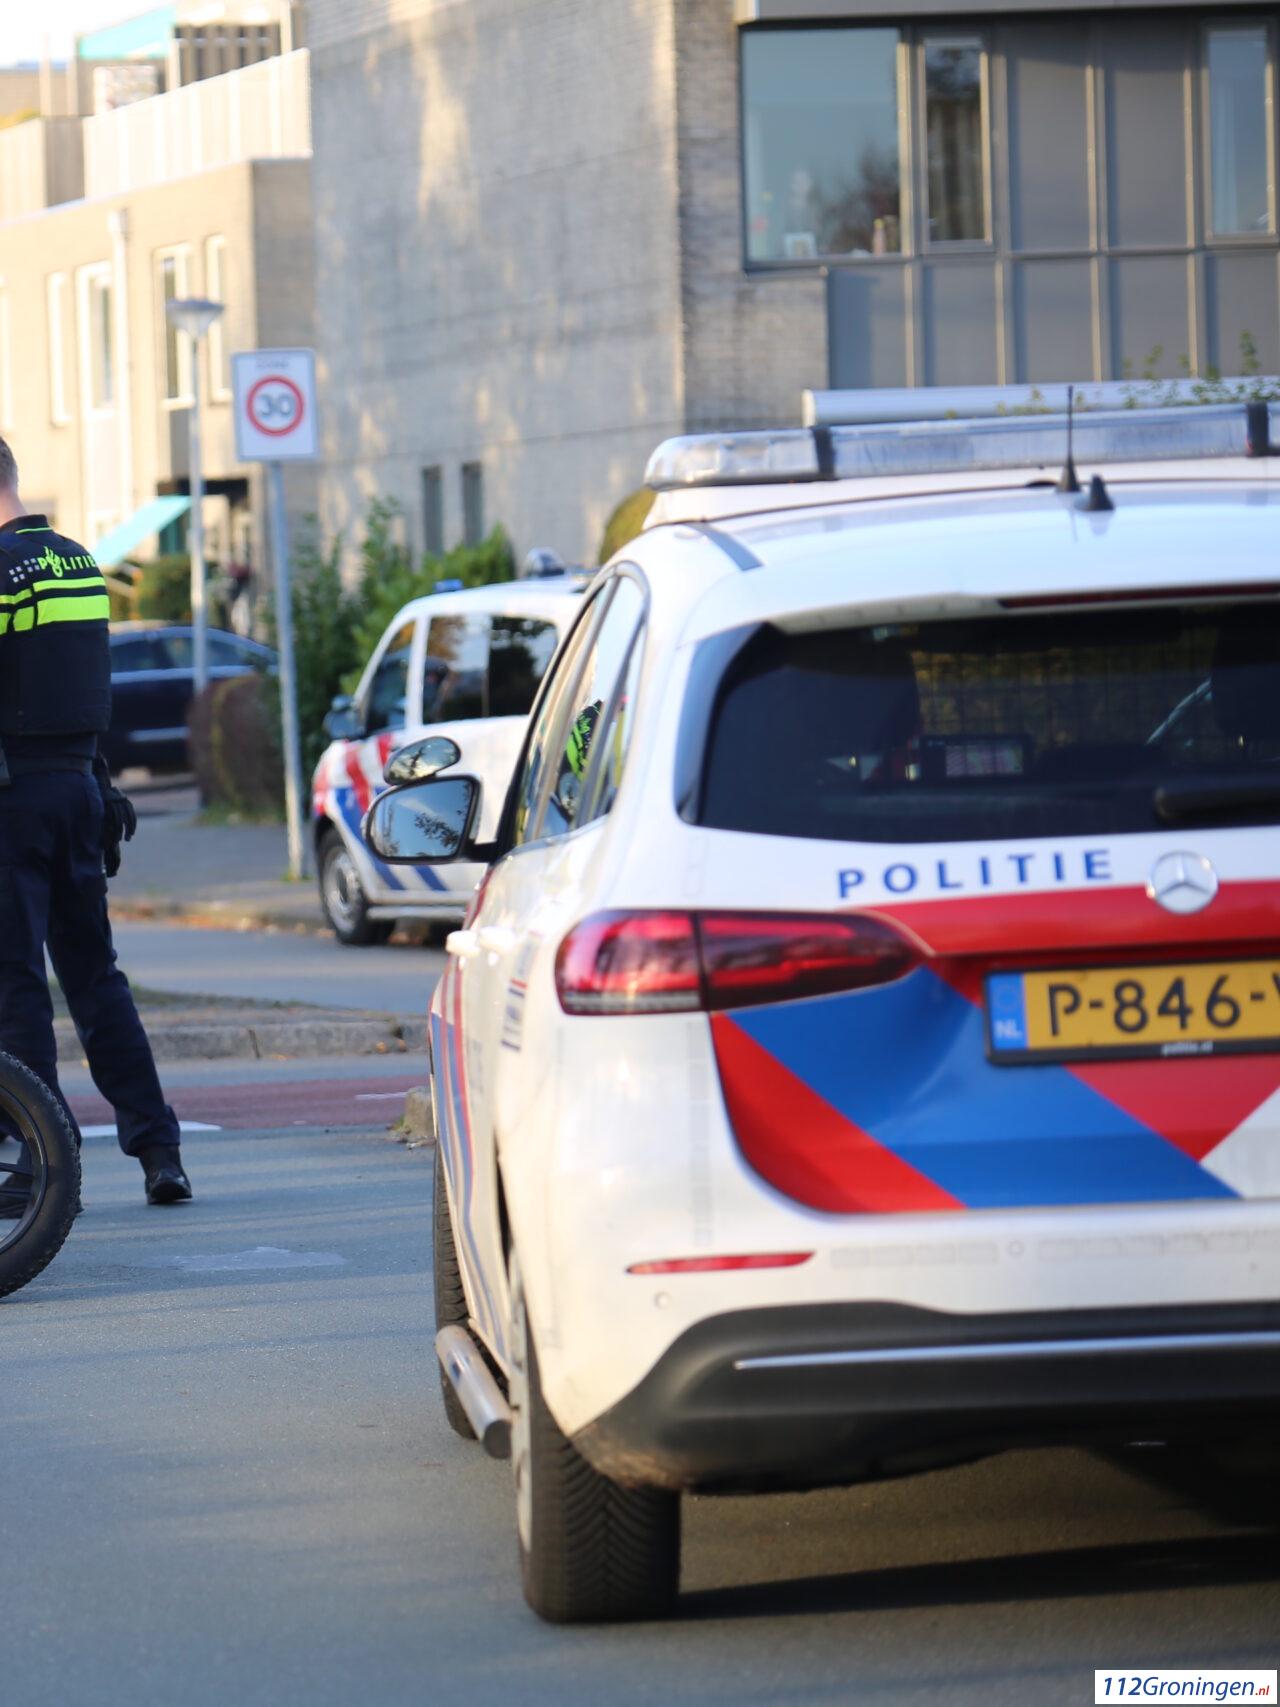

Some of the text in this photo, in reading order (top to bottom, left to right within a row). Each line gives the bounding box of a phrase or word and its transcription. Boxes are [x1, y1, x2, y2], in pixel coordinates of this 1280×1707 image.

[258, 394, 295, 418] 30
[837, 849, 1111, 898] POLITIE
[1048, 973, 1280, 1037] P-846-
[995, 1019, 1022, 1038] NL
